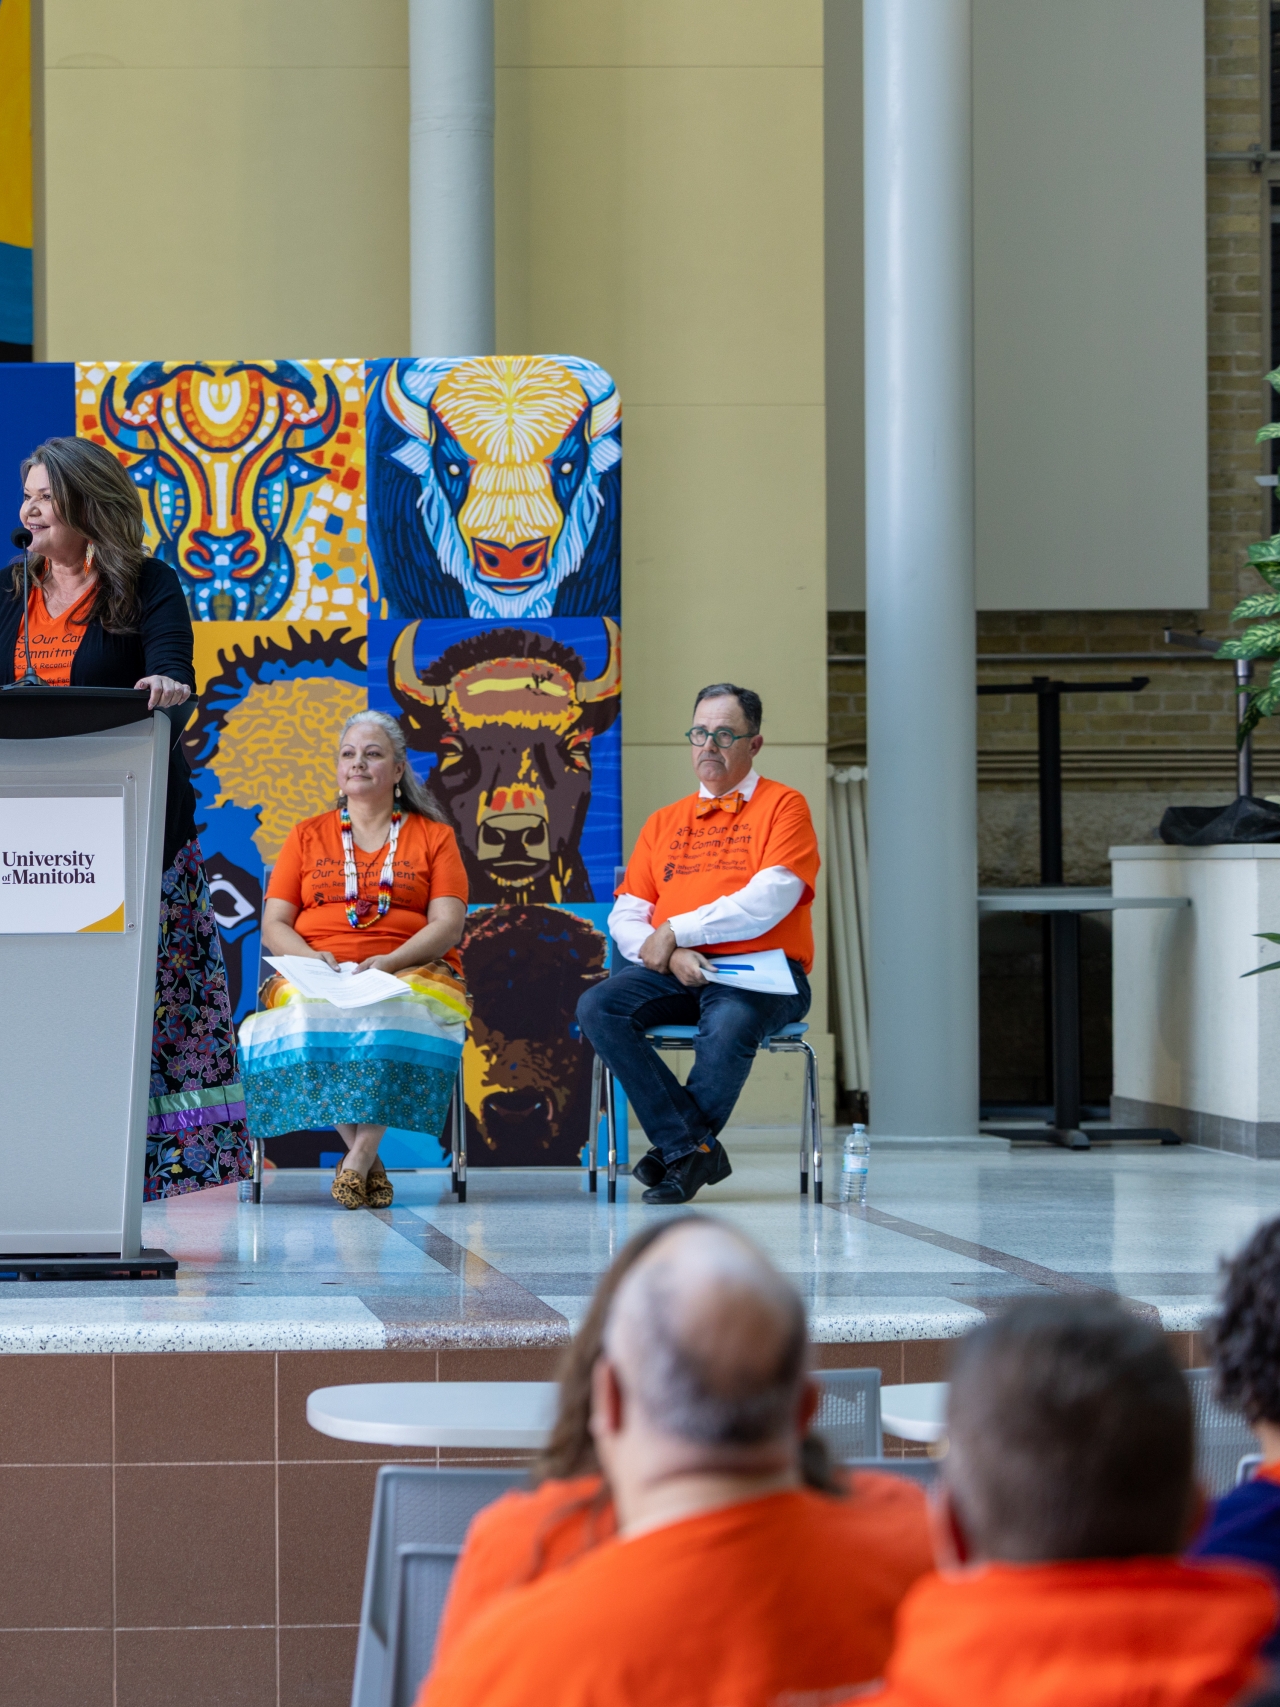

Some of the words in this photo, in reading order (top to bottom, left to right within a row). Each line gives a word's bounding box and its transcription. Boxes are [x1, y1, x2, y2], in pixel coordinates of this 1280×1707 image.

[31, 634, 58, 645] Our
[61, 633, 83, 643] Car
[14, 647, 78, 659] Commitme
[39, 661, 72, 670] Reconcil
[707, 826, 728, 836] Our
[691, 834, 752, 850] Commiment
[2, 850, 96, 870] University
[1, 873, 12, 885] of
[12, 868, 96, 885] Manitoba
[312, 869, 335, 880] Our
